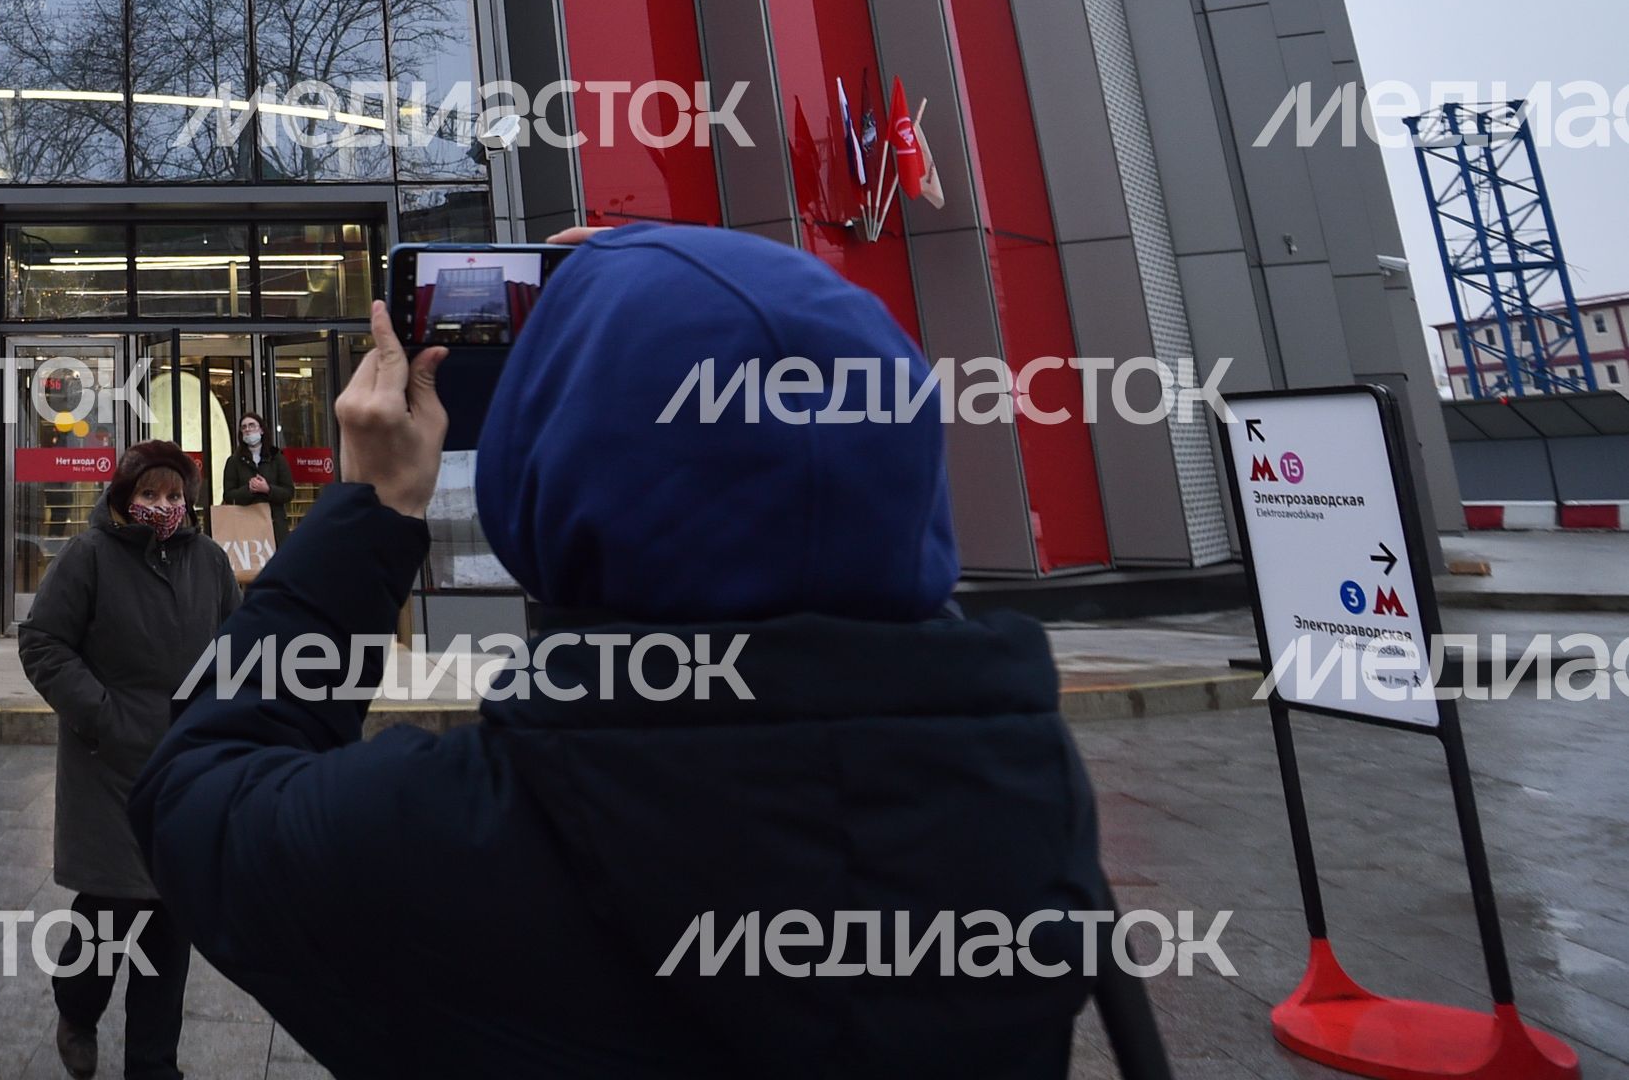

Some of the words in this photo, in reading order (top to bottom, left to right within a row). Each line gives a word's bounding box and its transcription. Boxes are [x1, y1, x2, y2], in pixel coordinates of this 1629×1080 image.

[1282, 458, 1301, 478] 15
[1253, 490, 1365, 507] Электрозаводская
[1346, 587, 1360, 610] 3
[1293, 614, 1413, 641] Электрозаводская
